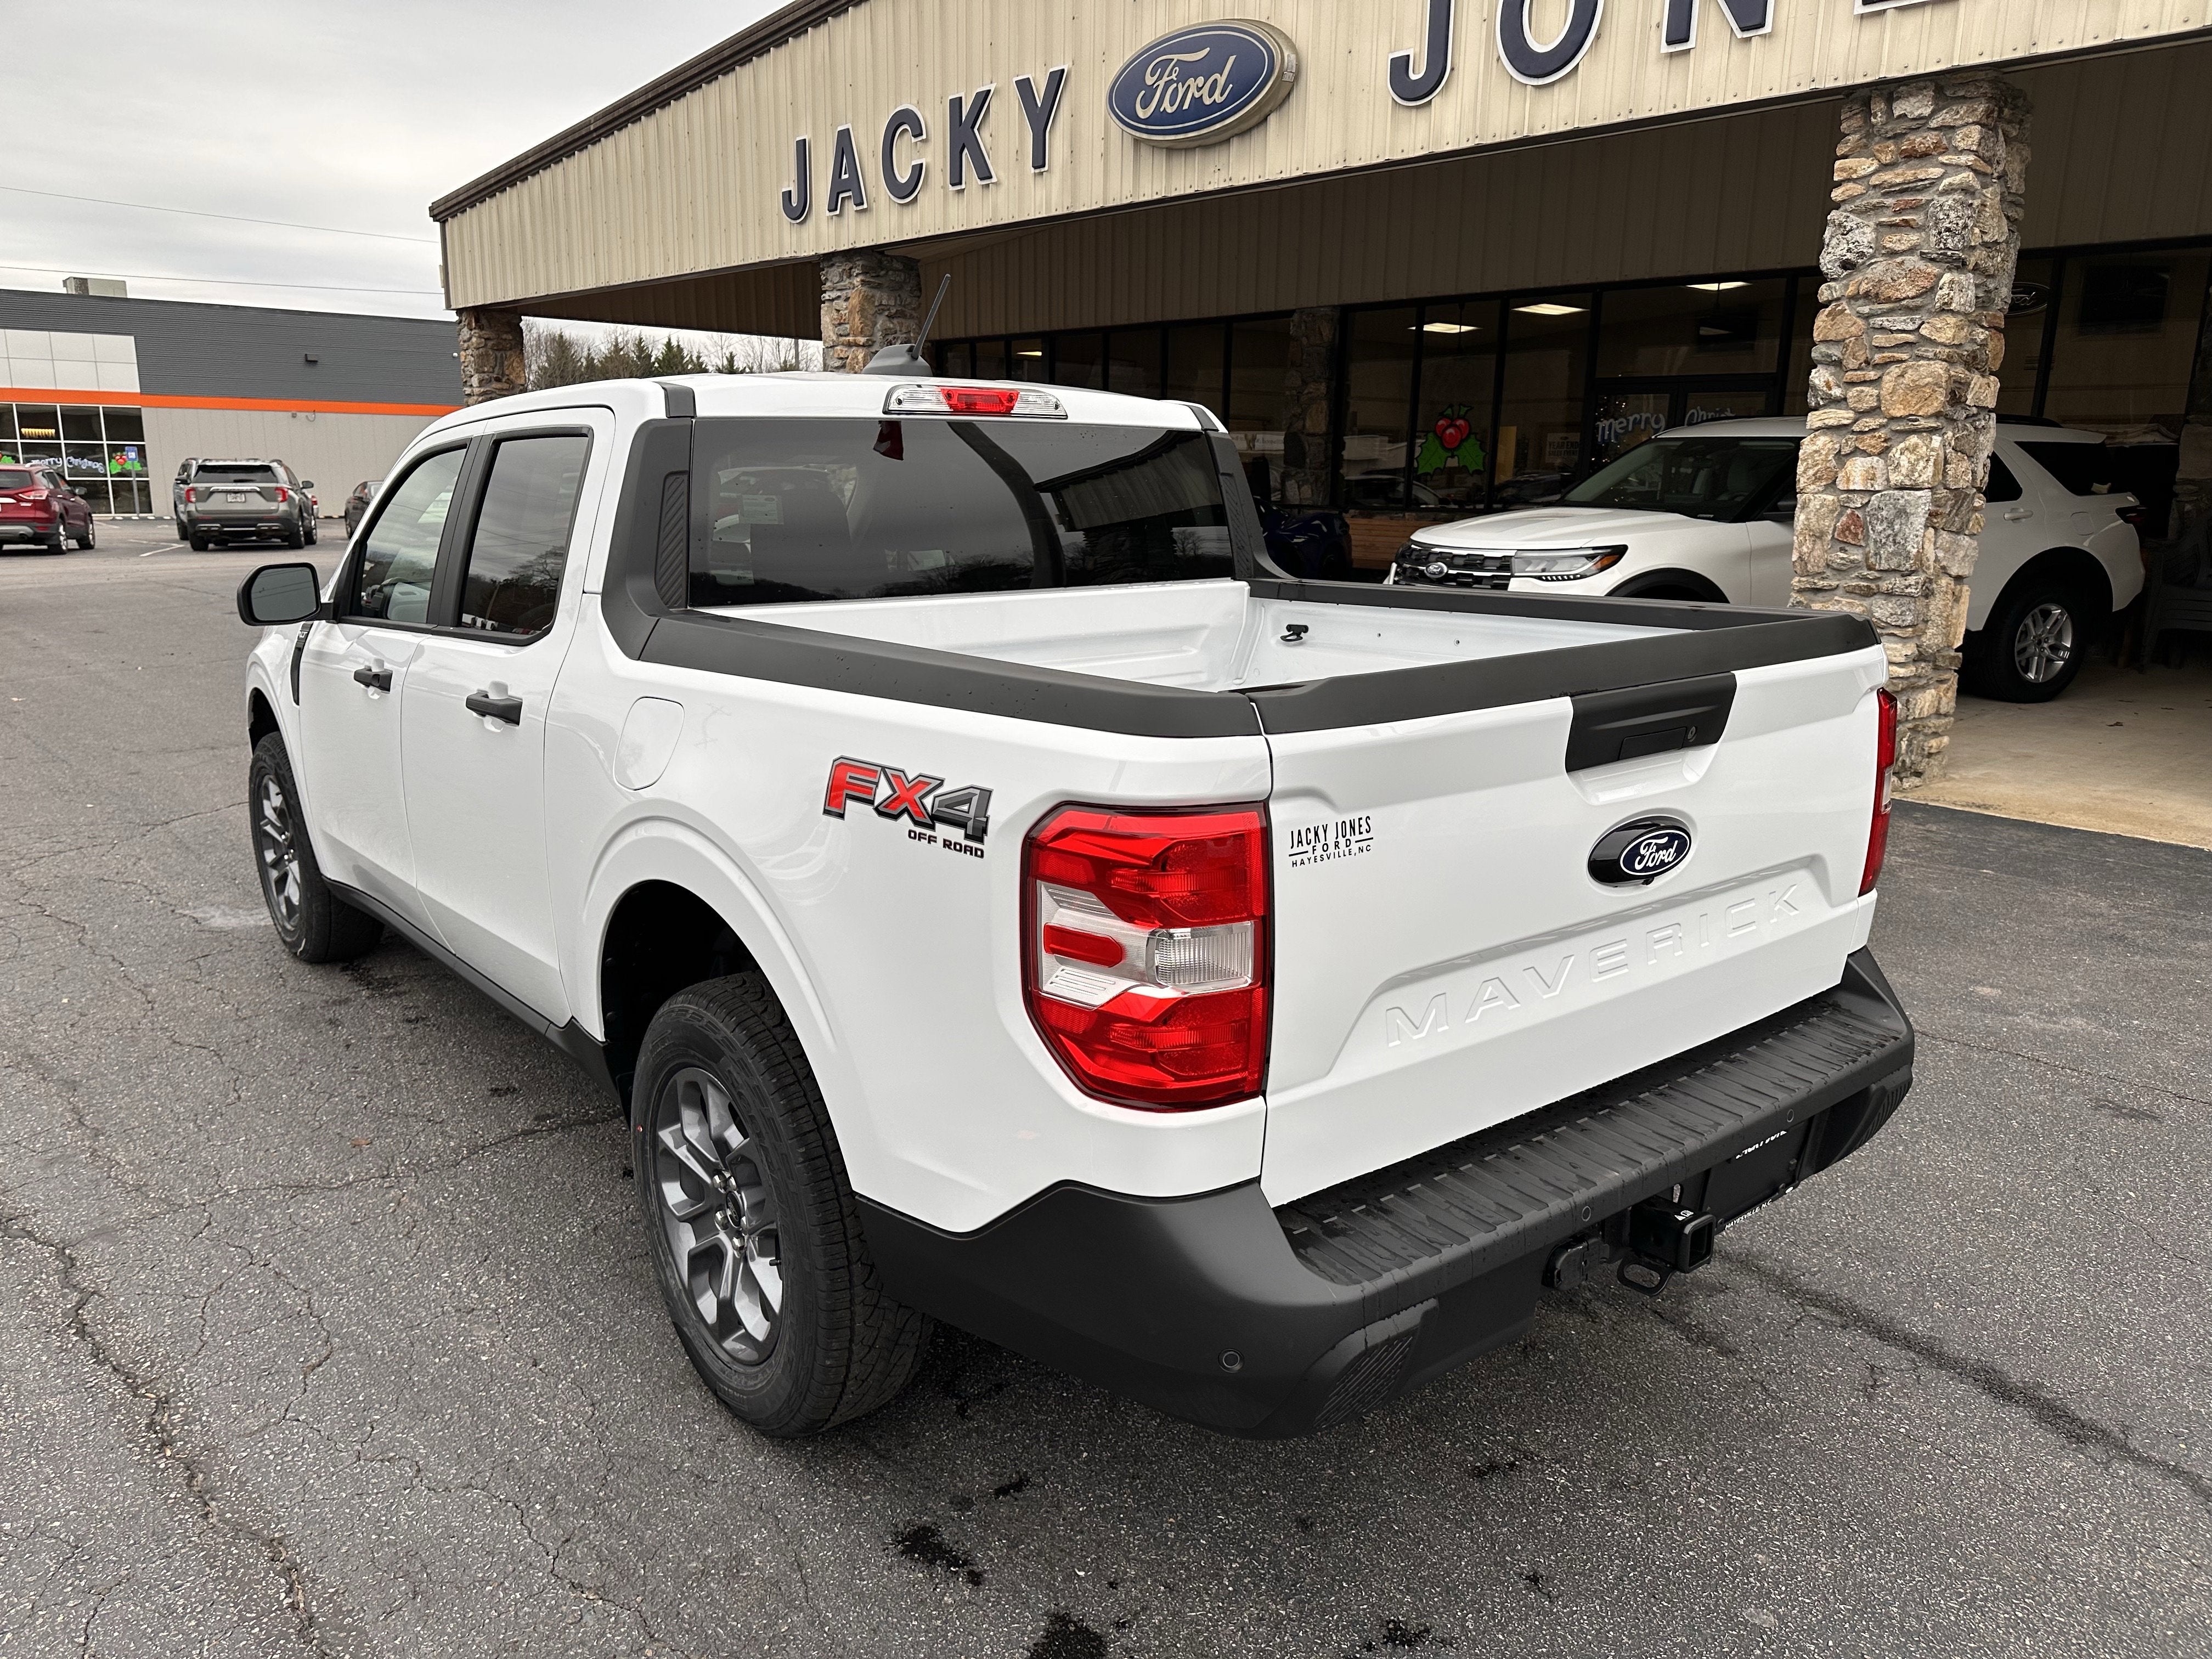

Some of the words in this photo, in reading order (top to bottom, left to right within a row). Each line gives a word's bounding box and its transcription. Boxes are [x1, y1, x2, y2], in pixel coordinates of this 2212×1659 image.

[781, 64, 1069, 224] JACKY
[1136, 47, 1237, 119] Ford
[822, 755, 994, 845] FX4
[908, 829, 937, 845] OFF
[943, 838, 984, 859] ROAD
[1290, 823, 1328, 849] JACKY
[1335, 815, 1371, 840] JONES
[1312, 838, 1351, 855] FORD
[1635, 836, 1678, 870] Ford
[1386, 884, 1801, 1047] MAVERICK
